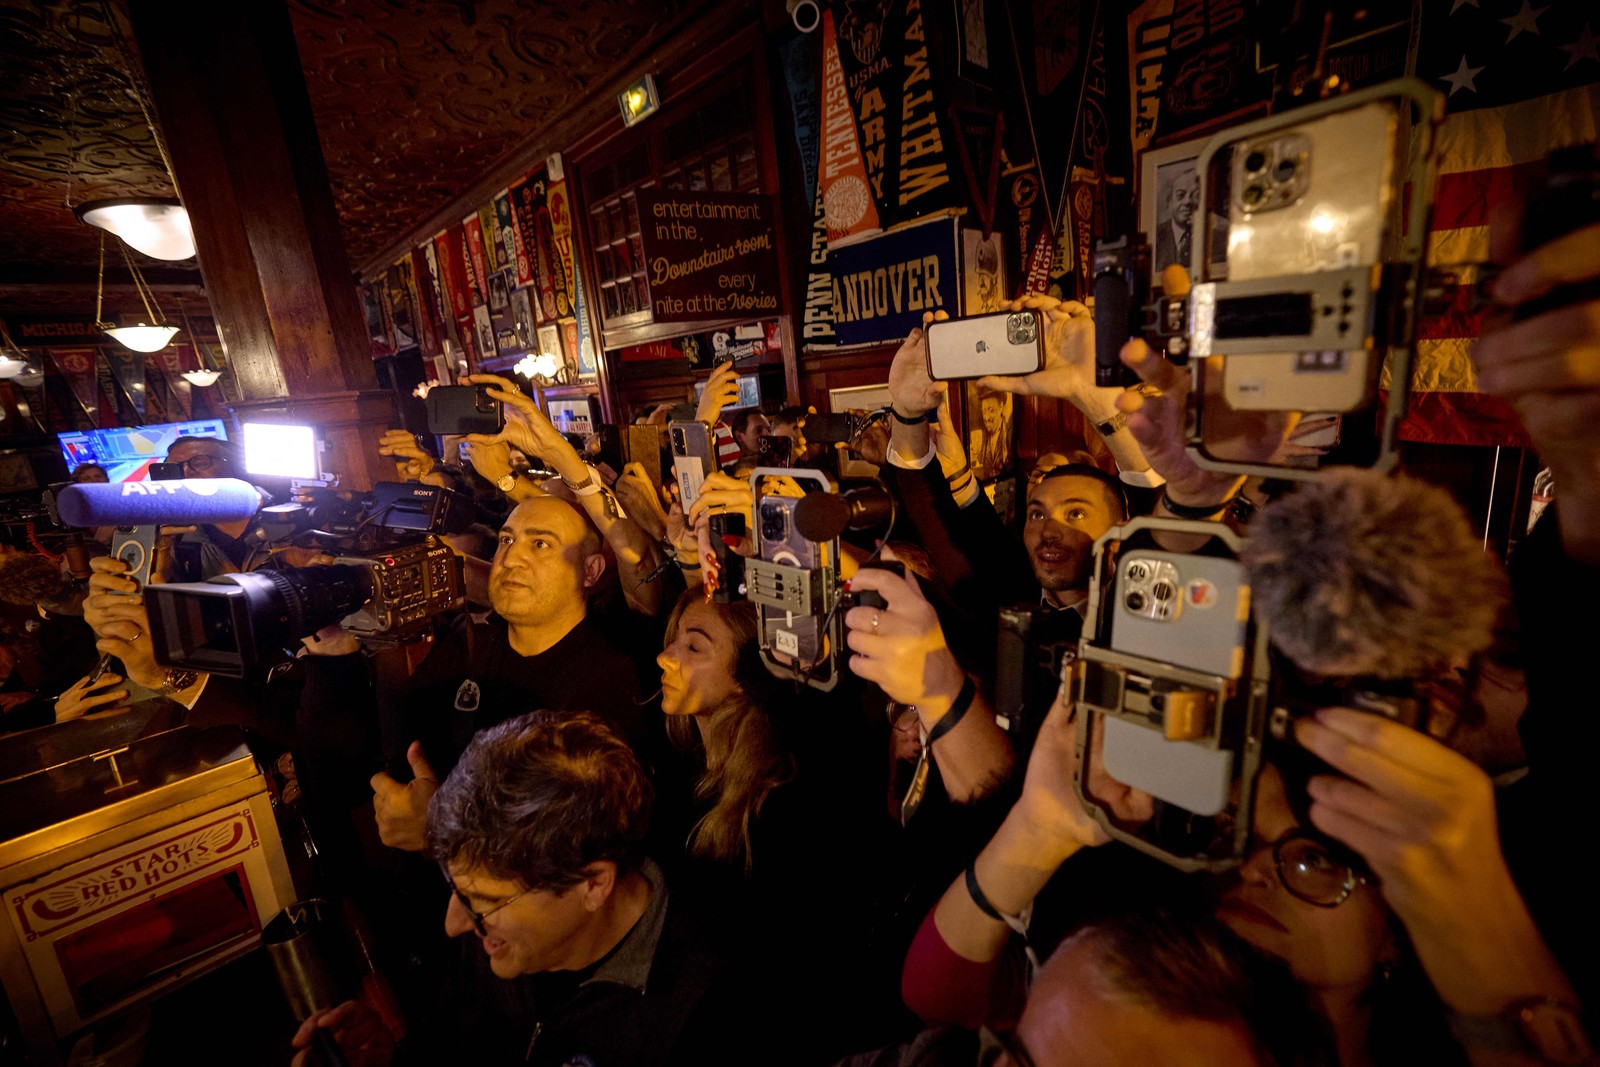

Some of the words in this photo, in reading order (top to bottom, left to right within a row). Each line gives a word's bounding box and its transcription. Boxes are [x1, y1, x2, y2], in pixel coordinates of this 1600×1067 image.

[1136, 15, 1172, 139] UCLA
[826, 41, 860, 179] TENNESSEE
[859, 86, 887, 200] ARMY
[653, 199, 761, 220] entertainment
[655, 221, 669, 240] in
[718, 273, 756, 292] every
[832, 253, 944, 325] ANDOVER
[655, 295, 684, 315] nite
[686, 295, 702, 313] at
[703, 293, 727, 312] the
[727, 290, 778, 310] Ivories
[803, 272, 837, 339] PENN
[20, 321, 105, 337] MICHIGA
[413, 489, 434, 497] SONY
[427, 547, 448, 558] SONY
[81, 876, 137, 900] RED
[144, 840, 210, 886] HOTS
[111, 844, 181, 879] STAR
